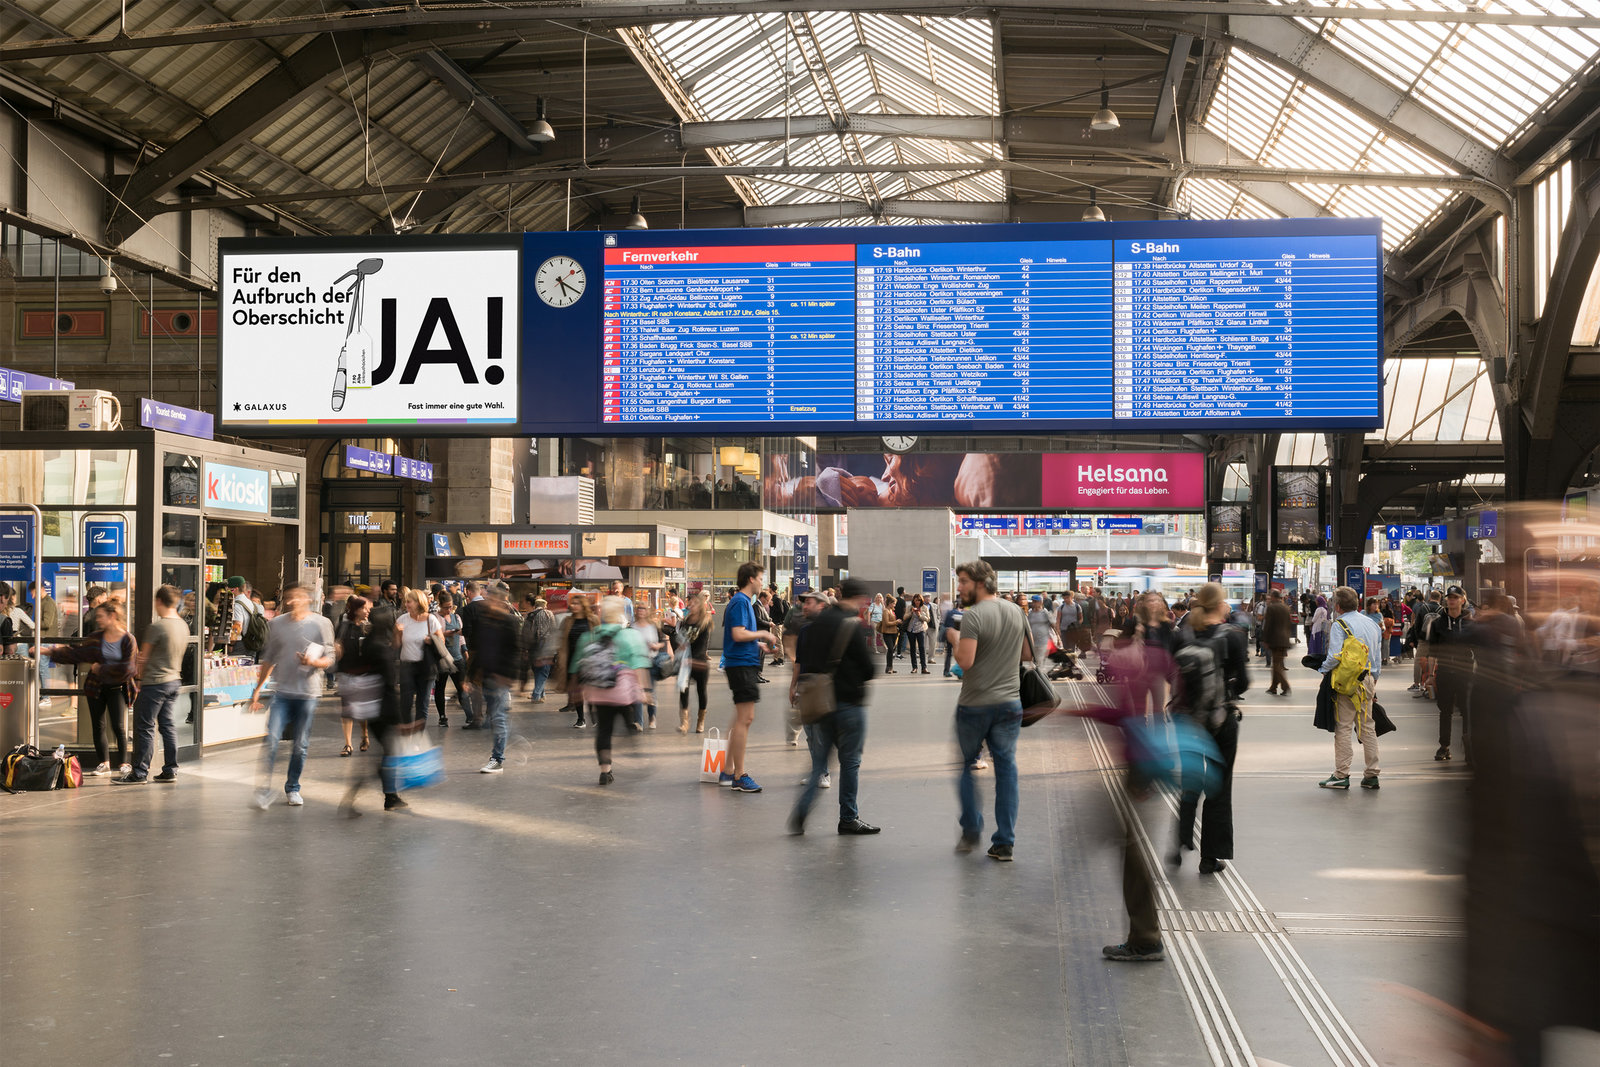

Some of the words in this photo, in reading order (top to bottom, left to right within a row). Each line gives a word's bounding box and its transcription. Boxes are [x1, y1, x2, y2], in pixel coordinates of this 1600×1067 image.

[873, 247, 920, 258] S-Bahn
[1131, 242, 1180, 254] S-Bahn
[623, 251, 698, 262] Fernverkehr
[233, 268, 262, 283] Für
[268, 266, 300, 282] den
[232, 286, 316, 304] Aufbruch
[322, 286, 353, 303] der
[232, 308, 344, 325] Oberschicht
[371, 296, 505, 386] JA!
[155, 406, 170, 417] Tourist
[171, 409, 187, 421] Service
[466, 402, 482, 411] gute
[1078, 464, 1168, 482] Helsana
[208, 471, 219, 500] k
[221, 472, 265, 506] kiosk
[1078, 486, 1114, 496] Engagiert
[1144, 486, 1169, 494] Leben.
[504, 540, 532, 549] BUFFET
[534, 540, 569, 549] EXPRESS
[704, 749, 726, 773] M
